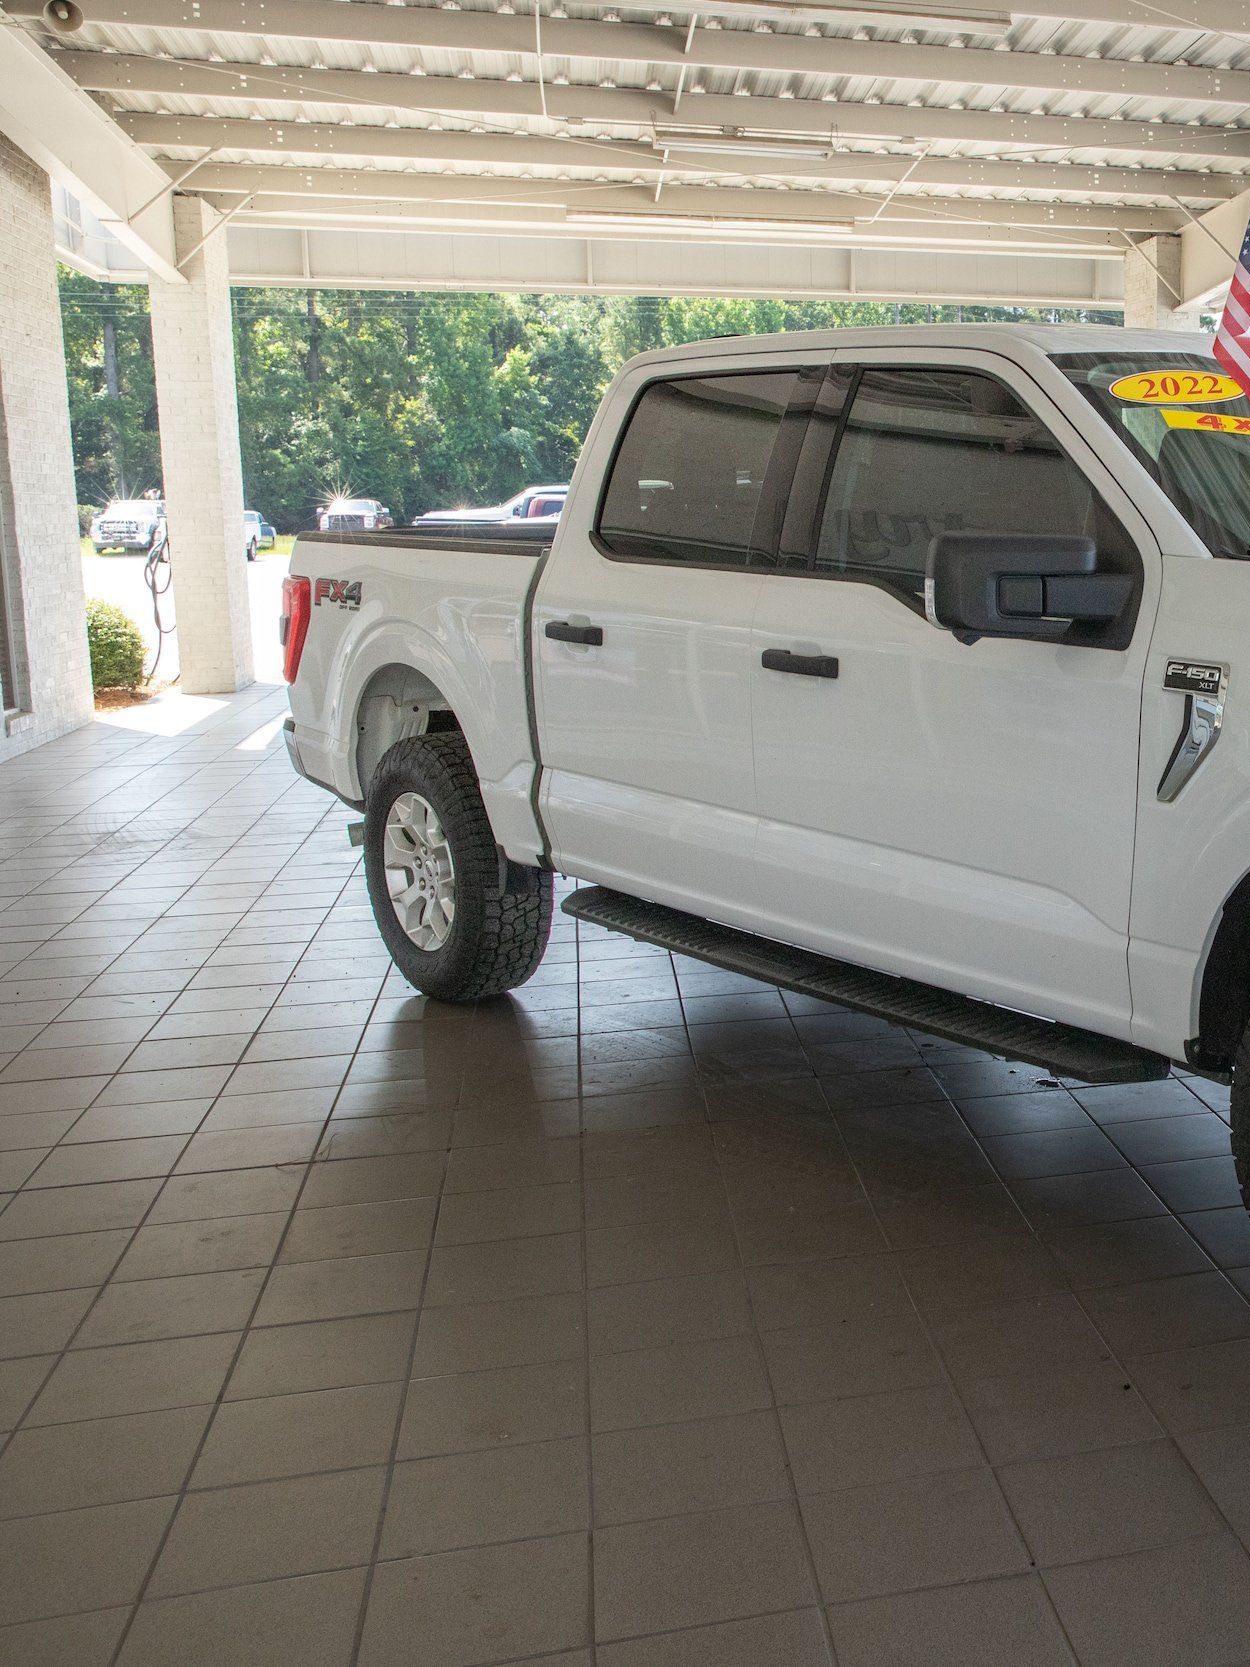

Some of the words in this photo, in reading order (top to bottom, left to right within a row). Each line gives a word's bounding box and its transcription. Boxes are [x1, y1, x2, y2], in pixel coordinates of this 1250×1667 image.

[1138, 375, 1223, 399] 2022
[315, 577, 362, 606] FX4
[1167, 664, 1220, 681] F-150
[1199, 682, 1215, 690] XLT
